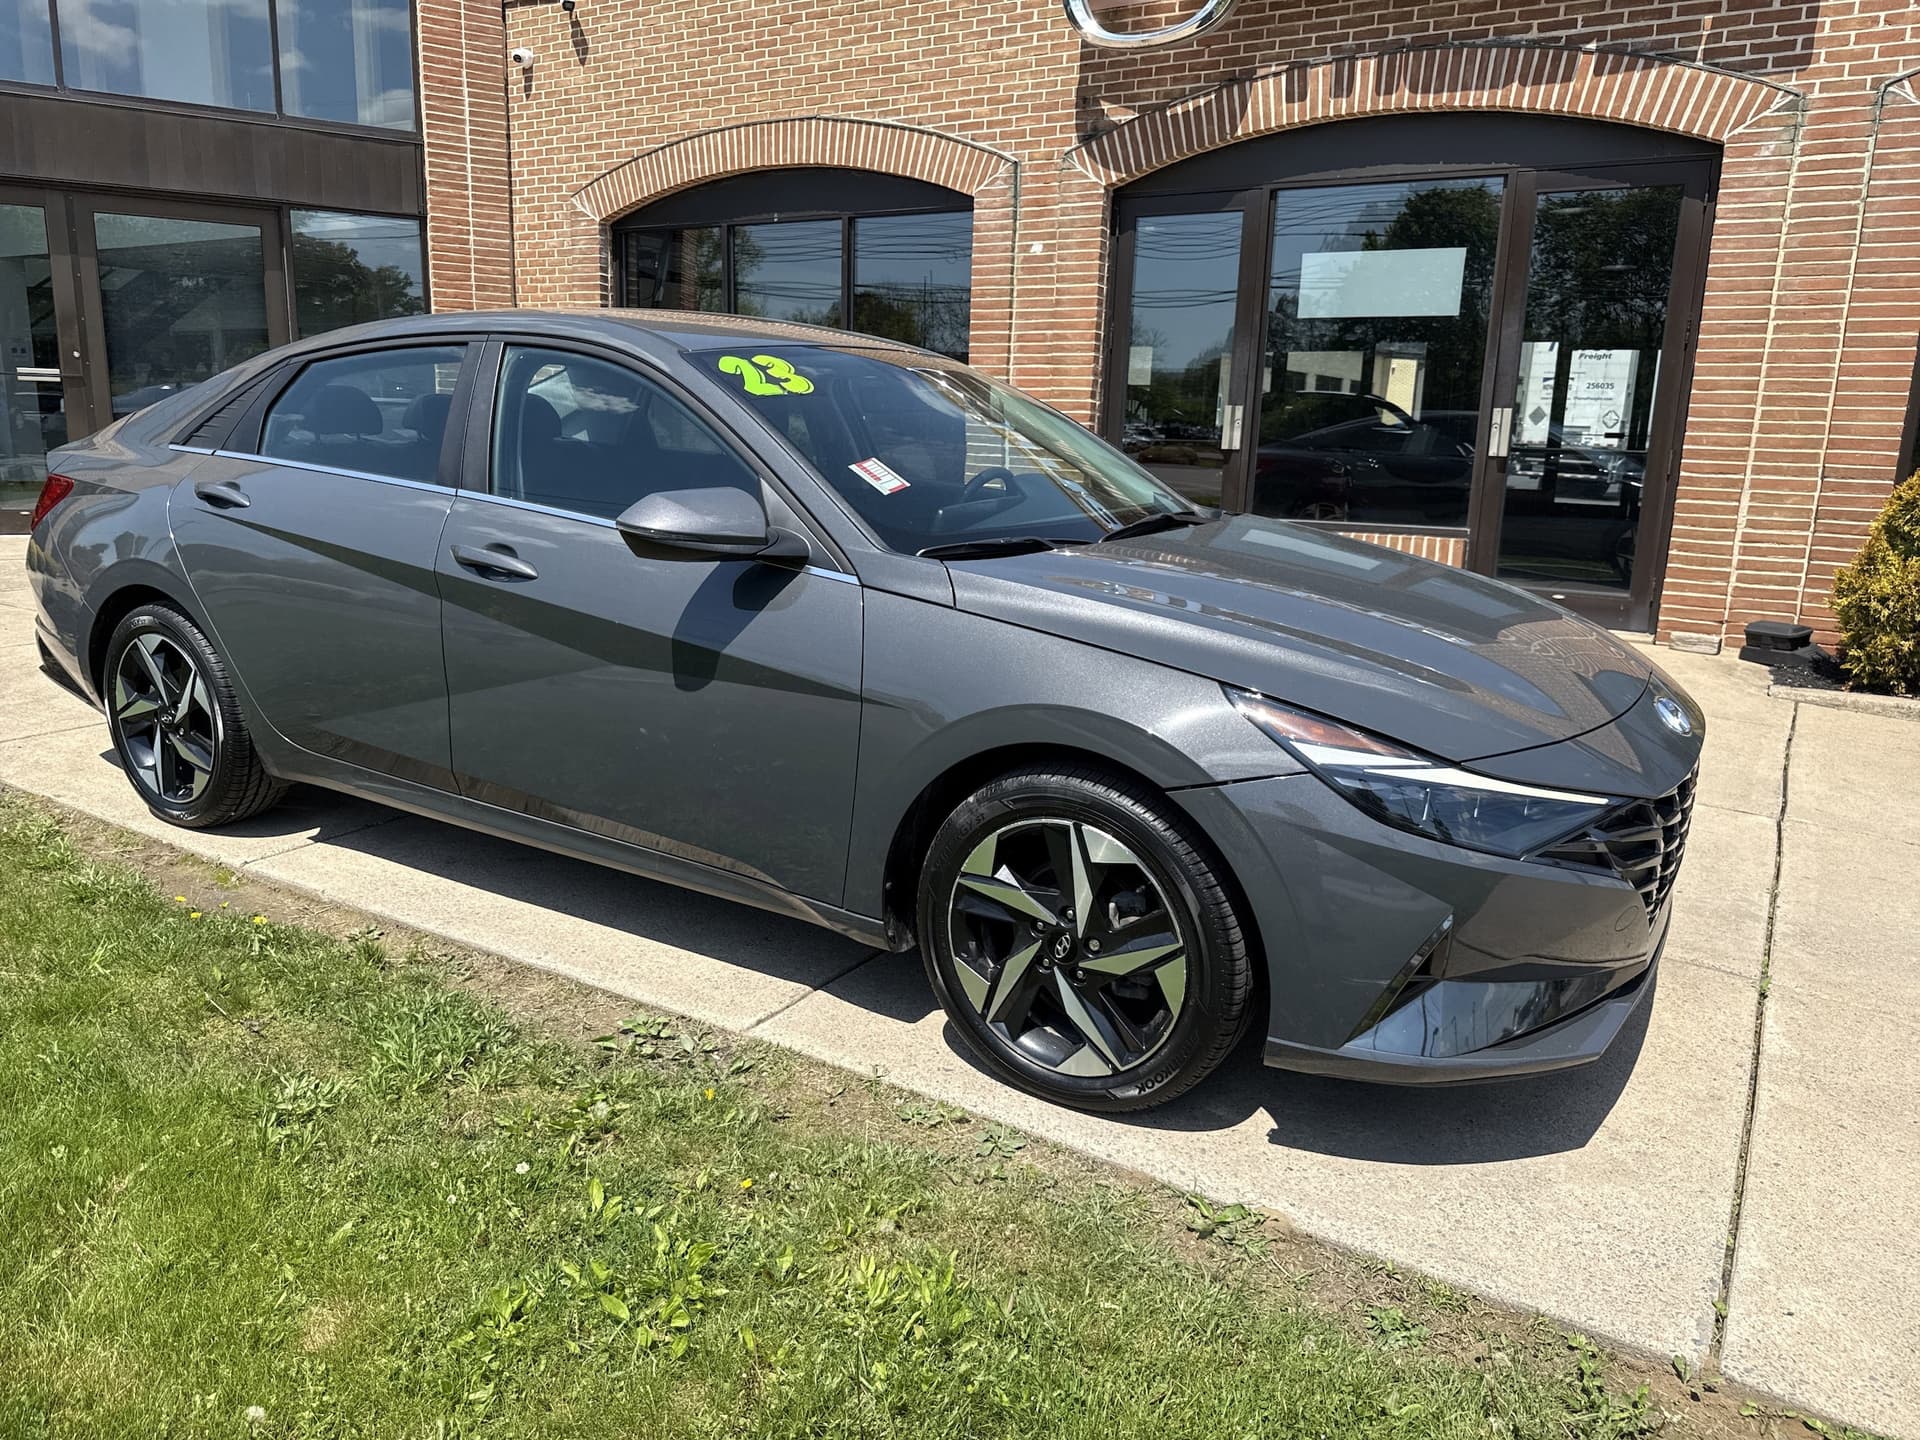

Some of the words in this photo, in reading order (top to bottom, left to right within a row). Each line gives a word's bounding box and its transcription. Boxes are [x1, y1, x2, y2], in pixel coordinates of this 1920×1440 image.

[1578, 353, 1612, 361] Freight
[718, 354, 815, 395] 23
[1586, 382, 1615, 390] 256035
